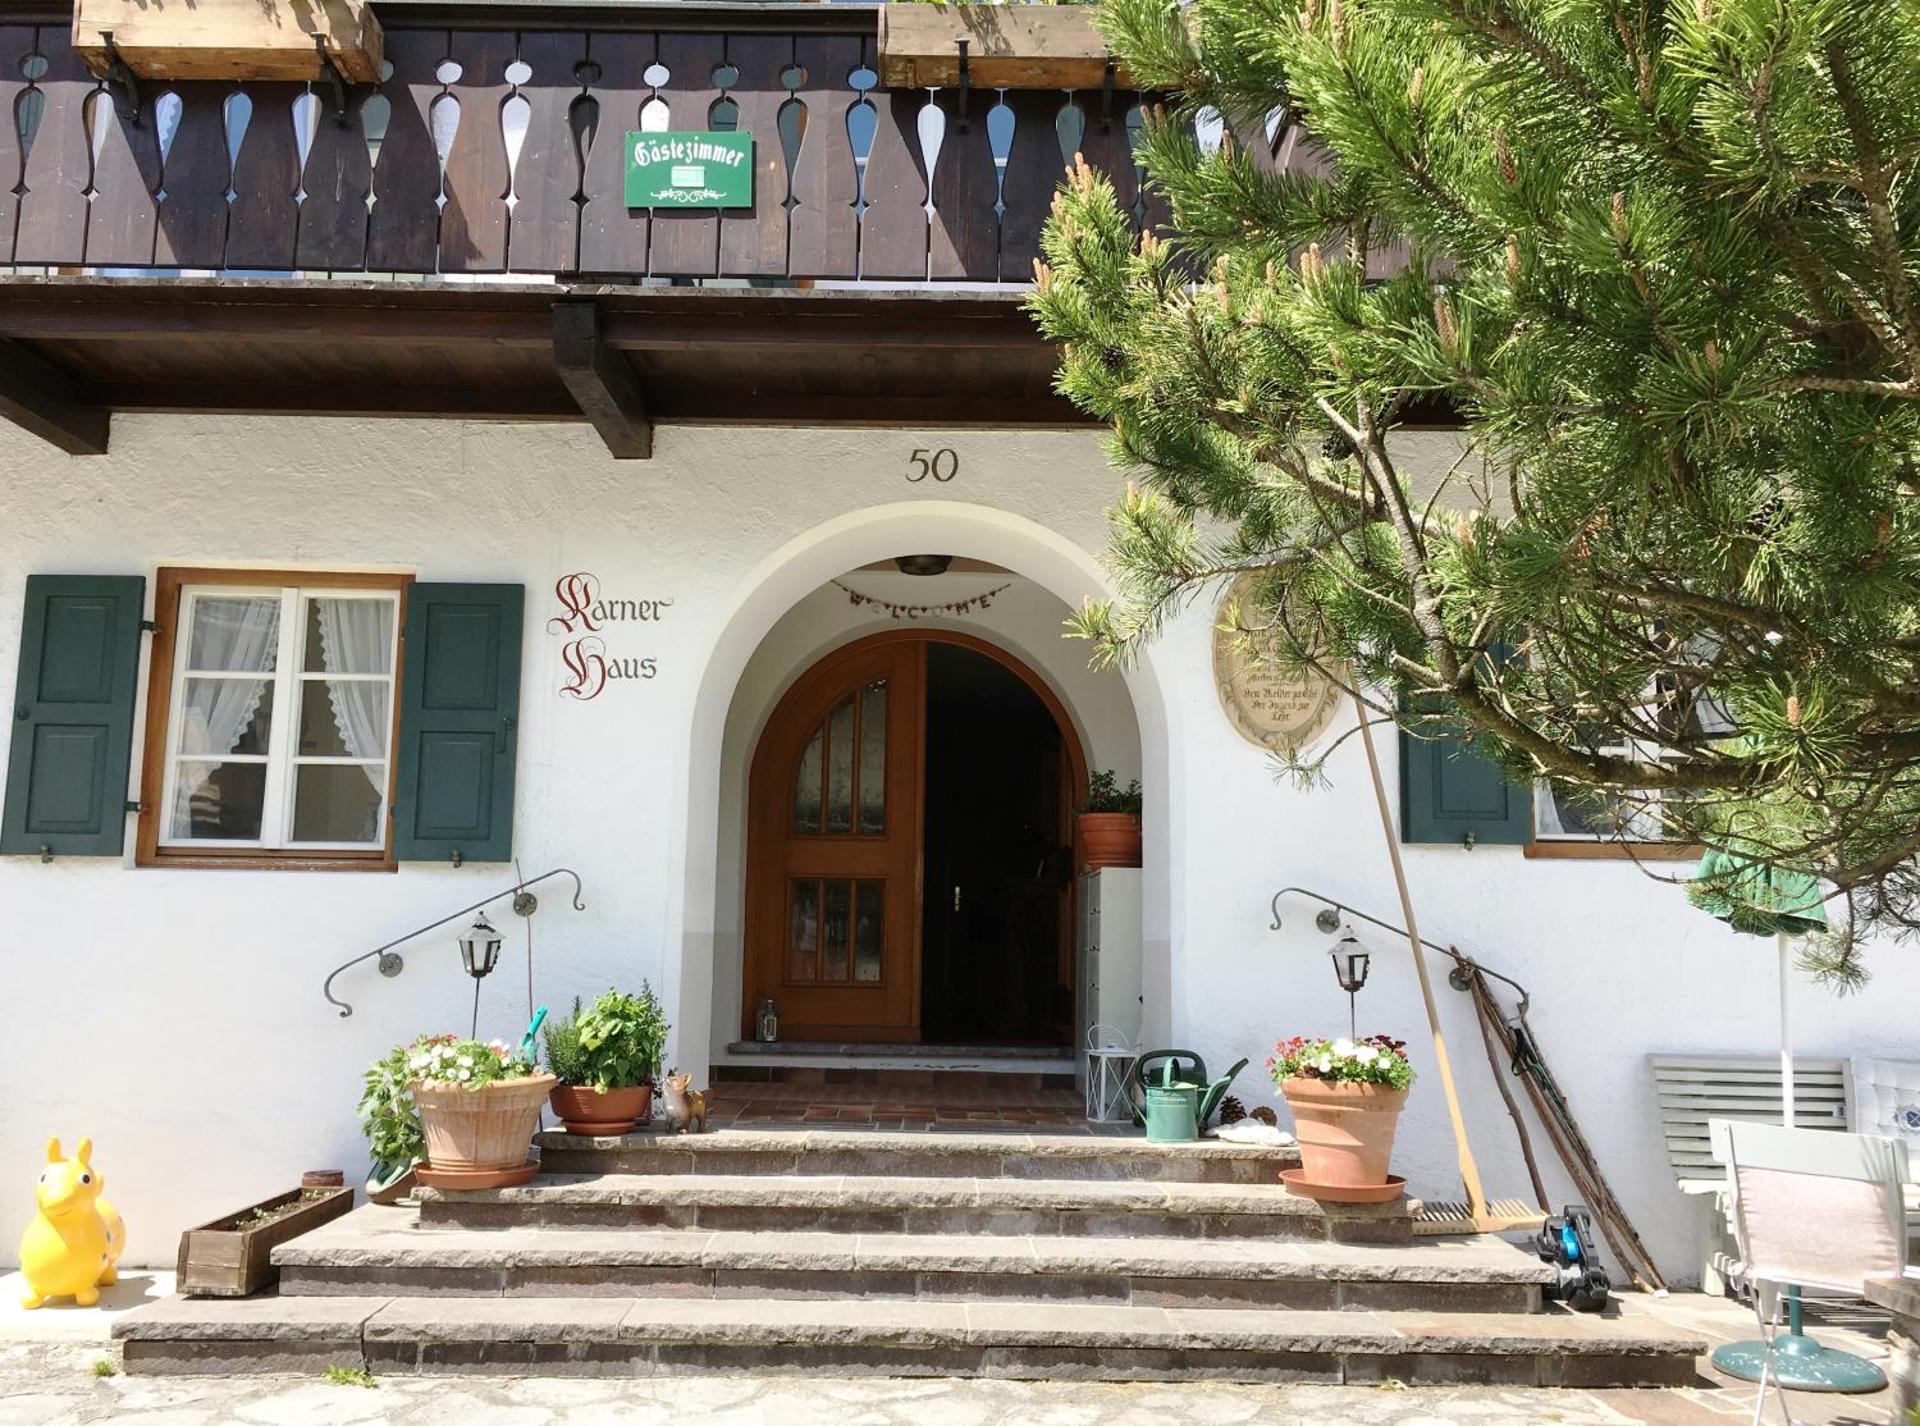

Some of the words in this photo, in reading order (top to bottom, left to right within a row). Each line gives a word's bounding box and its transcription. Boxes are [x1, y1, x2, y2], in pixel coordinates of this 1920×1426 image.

[634, 136, 744, 167] Gästezimmer
[906, 449, 959, 482] 50
[546, 572, 674, 635] Karner
[850, 589, 991, 620] WELCOME
[559, 636, 657, 700] Haus
